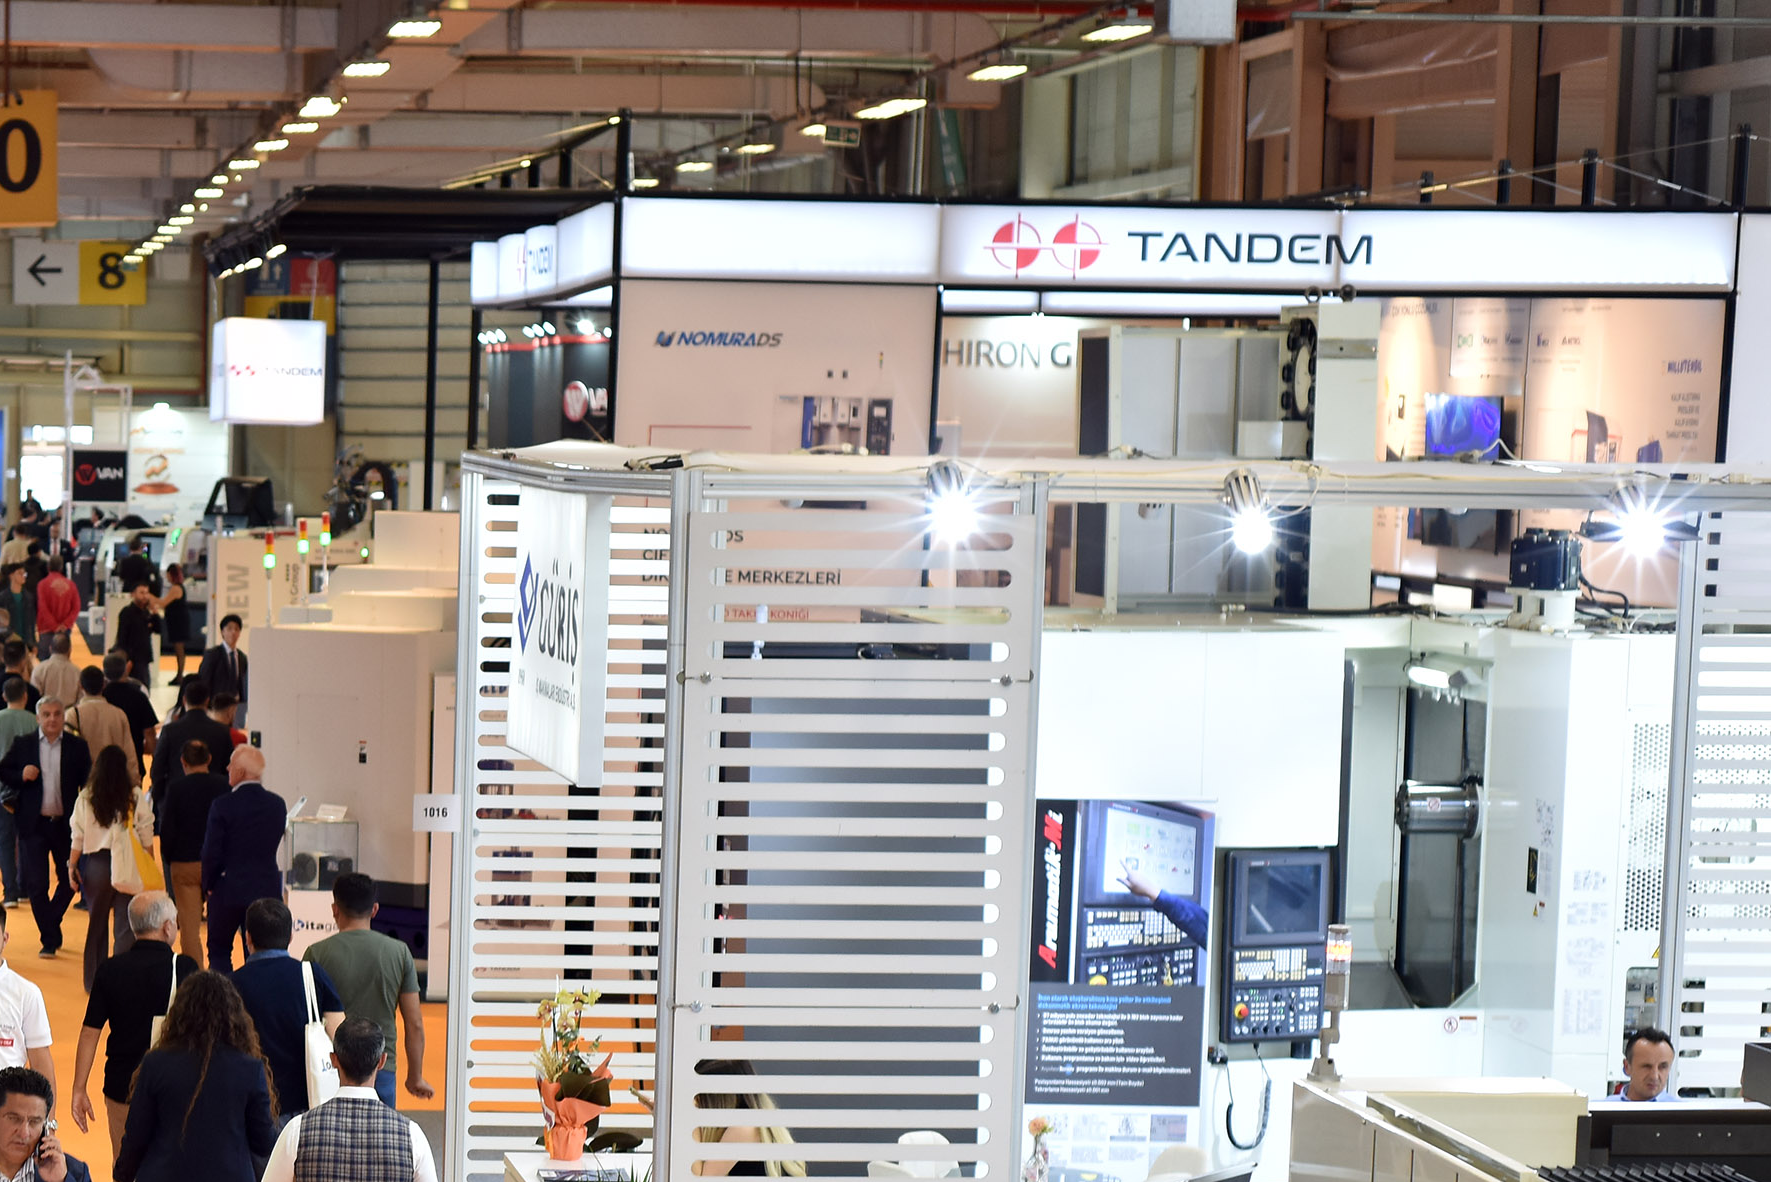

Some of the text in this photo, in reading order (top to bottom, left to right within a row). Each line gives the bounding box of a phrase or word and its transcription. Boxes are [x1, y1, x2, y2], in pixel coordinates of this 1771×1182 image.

[1128, 232, 1373, 265] TANDEM
[98, 252, 126, 290] 8
[677, 331, 783, 347] NOMURADS
[96, 467, 124, 482] VAN
[738, 568, 841, 585] MERKEZLERİ
[423, 807, 448, 818] 1016
